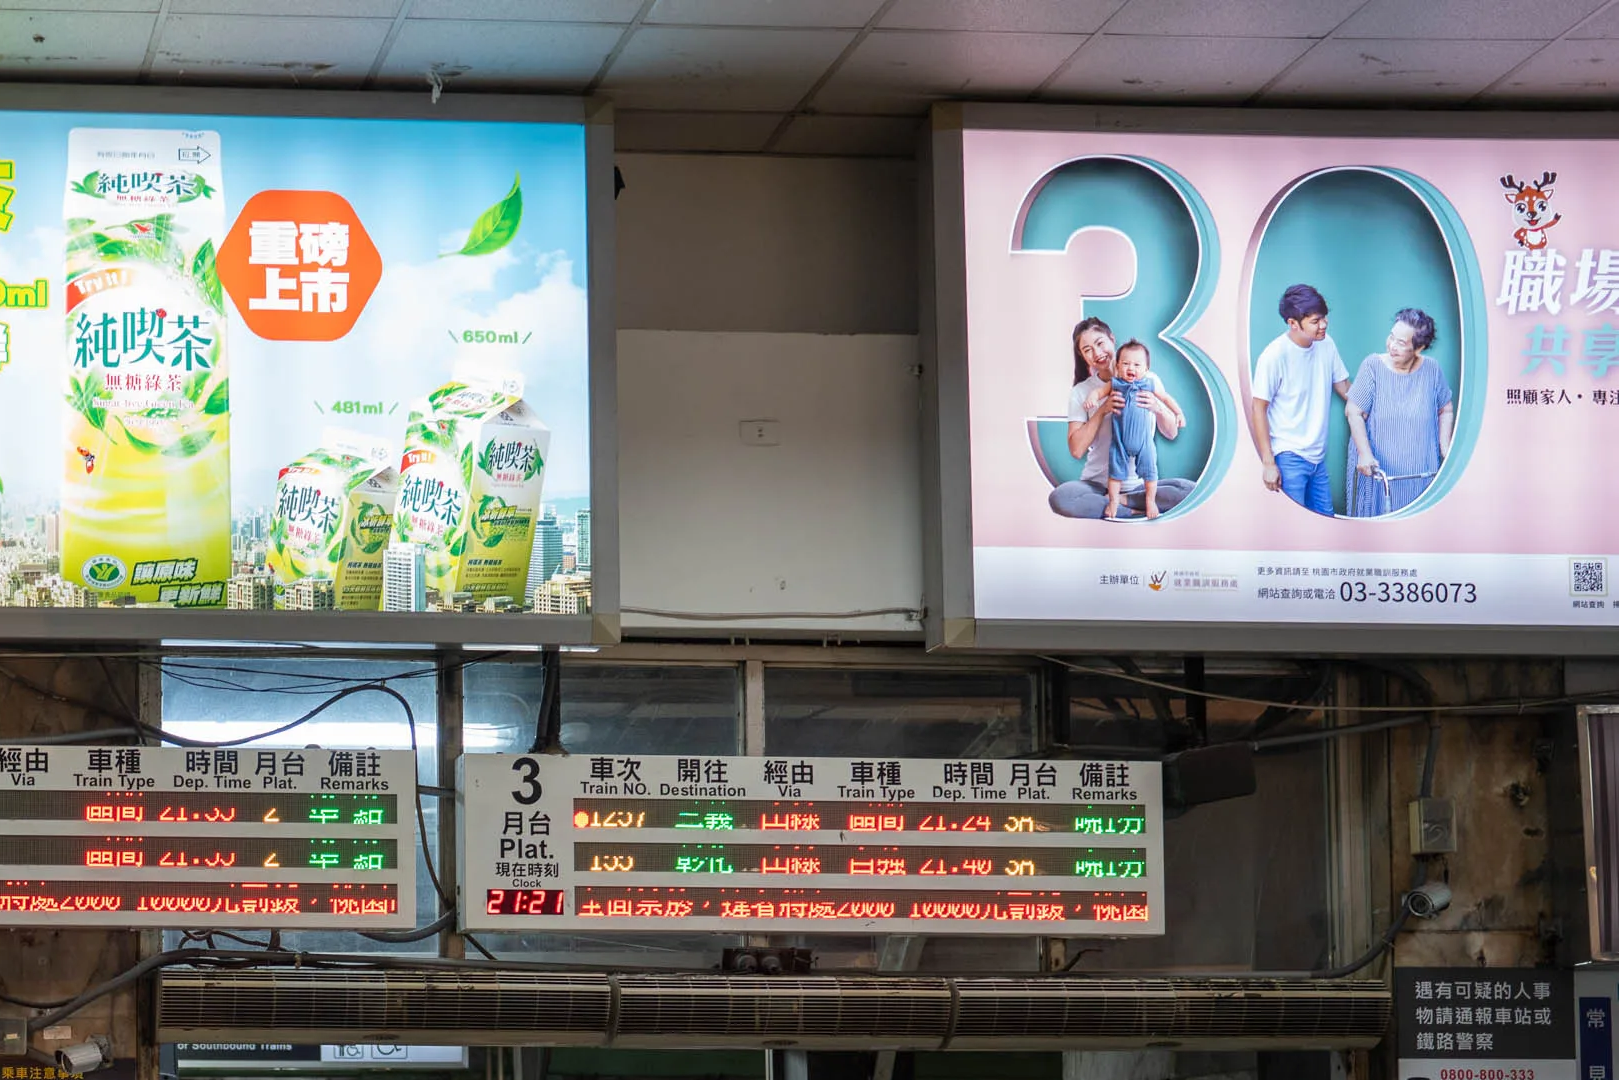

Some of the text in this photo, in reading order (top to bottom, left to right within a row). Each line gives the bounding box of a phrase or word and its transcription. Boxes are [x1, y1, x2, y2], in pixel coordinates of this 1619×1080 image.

[96, 172, 196, 196] 純喫茶
[248, 220, 351, 268] 重磅
[248, 269, 350, 313] 上市
[1496, 248, 1619, 316] 職場
[73, 307, 213, 371] 純喫茶
[1009, 153, 1489, 524] 30
[1520, 323, 1619, 378] 共享
[401, 474, 462, 527] 純喫茶
[1099, 574, 1140, 586] 主辦單位
[1257, 581, 1478, 604] 網站查詢或電洽 03-3386073
[87, 749, 141, 773] 車種
[185, 750, 238, 774] 時間
[255, 752, 305, 776] 月台
[328, 752, 381, 777] 備註
[590, 758, 1130, 788] 車次 開往 經由 車種 時間 月台 備註
[11, 773, 35, 786] Via
[73, 774, 115, 787] Train
[118, 774, 155, 789] Type
[173, 775, 209, 790] Dep.
[214, 776, 251, 788] Time
[263, 777, 297, 790] Plat.
[320, 777, 389, 791] Remarks
[511, 757, 542, 805] 3
[581, 781, 1137, 801] Train NO. Destination Via Train Type Dep. Time Plat. Remarks
[503, 811, 551, 836] 月台
[501, 838, 554, 859] Plat.
[496, 862, 559, 878] 現在時刻
[512, 879, 542, 888] Clock
[487, 890, 564, 915] 21:21
[1415, 981, 1551, 1000] 遇有可疑的人事
[1415, 1007, 1551, 1026] 物請通報車站或
[1416, 1032, 1494, 1051] 鐵路警察
[1440, 1068, 1535, 1080] 0800-800-333
